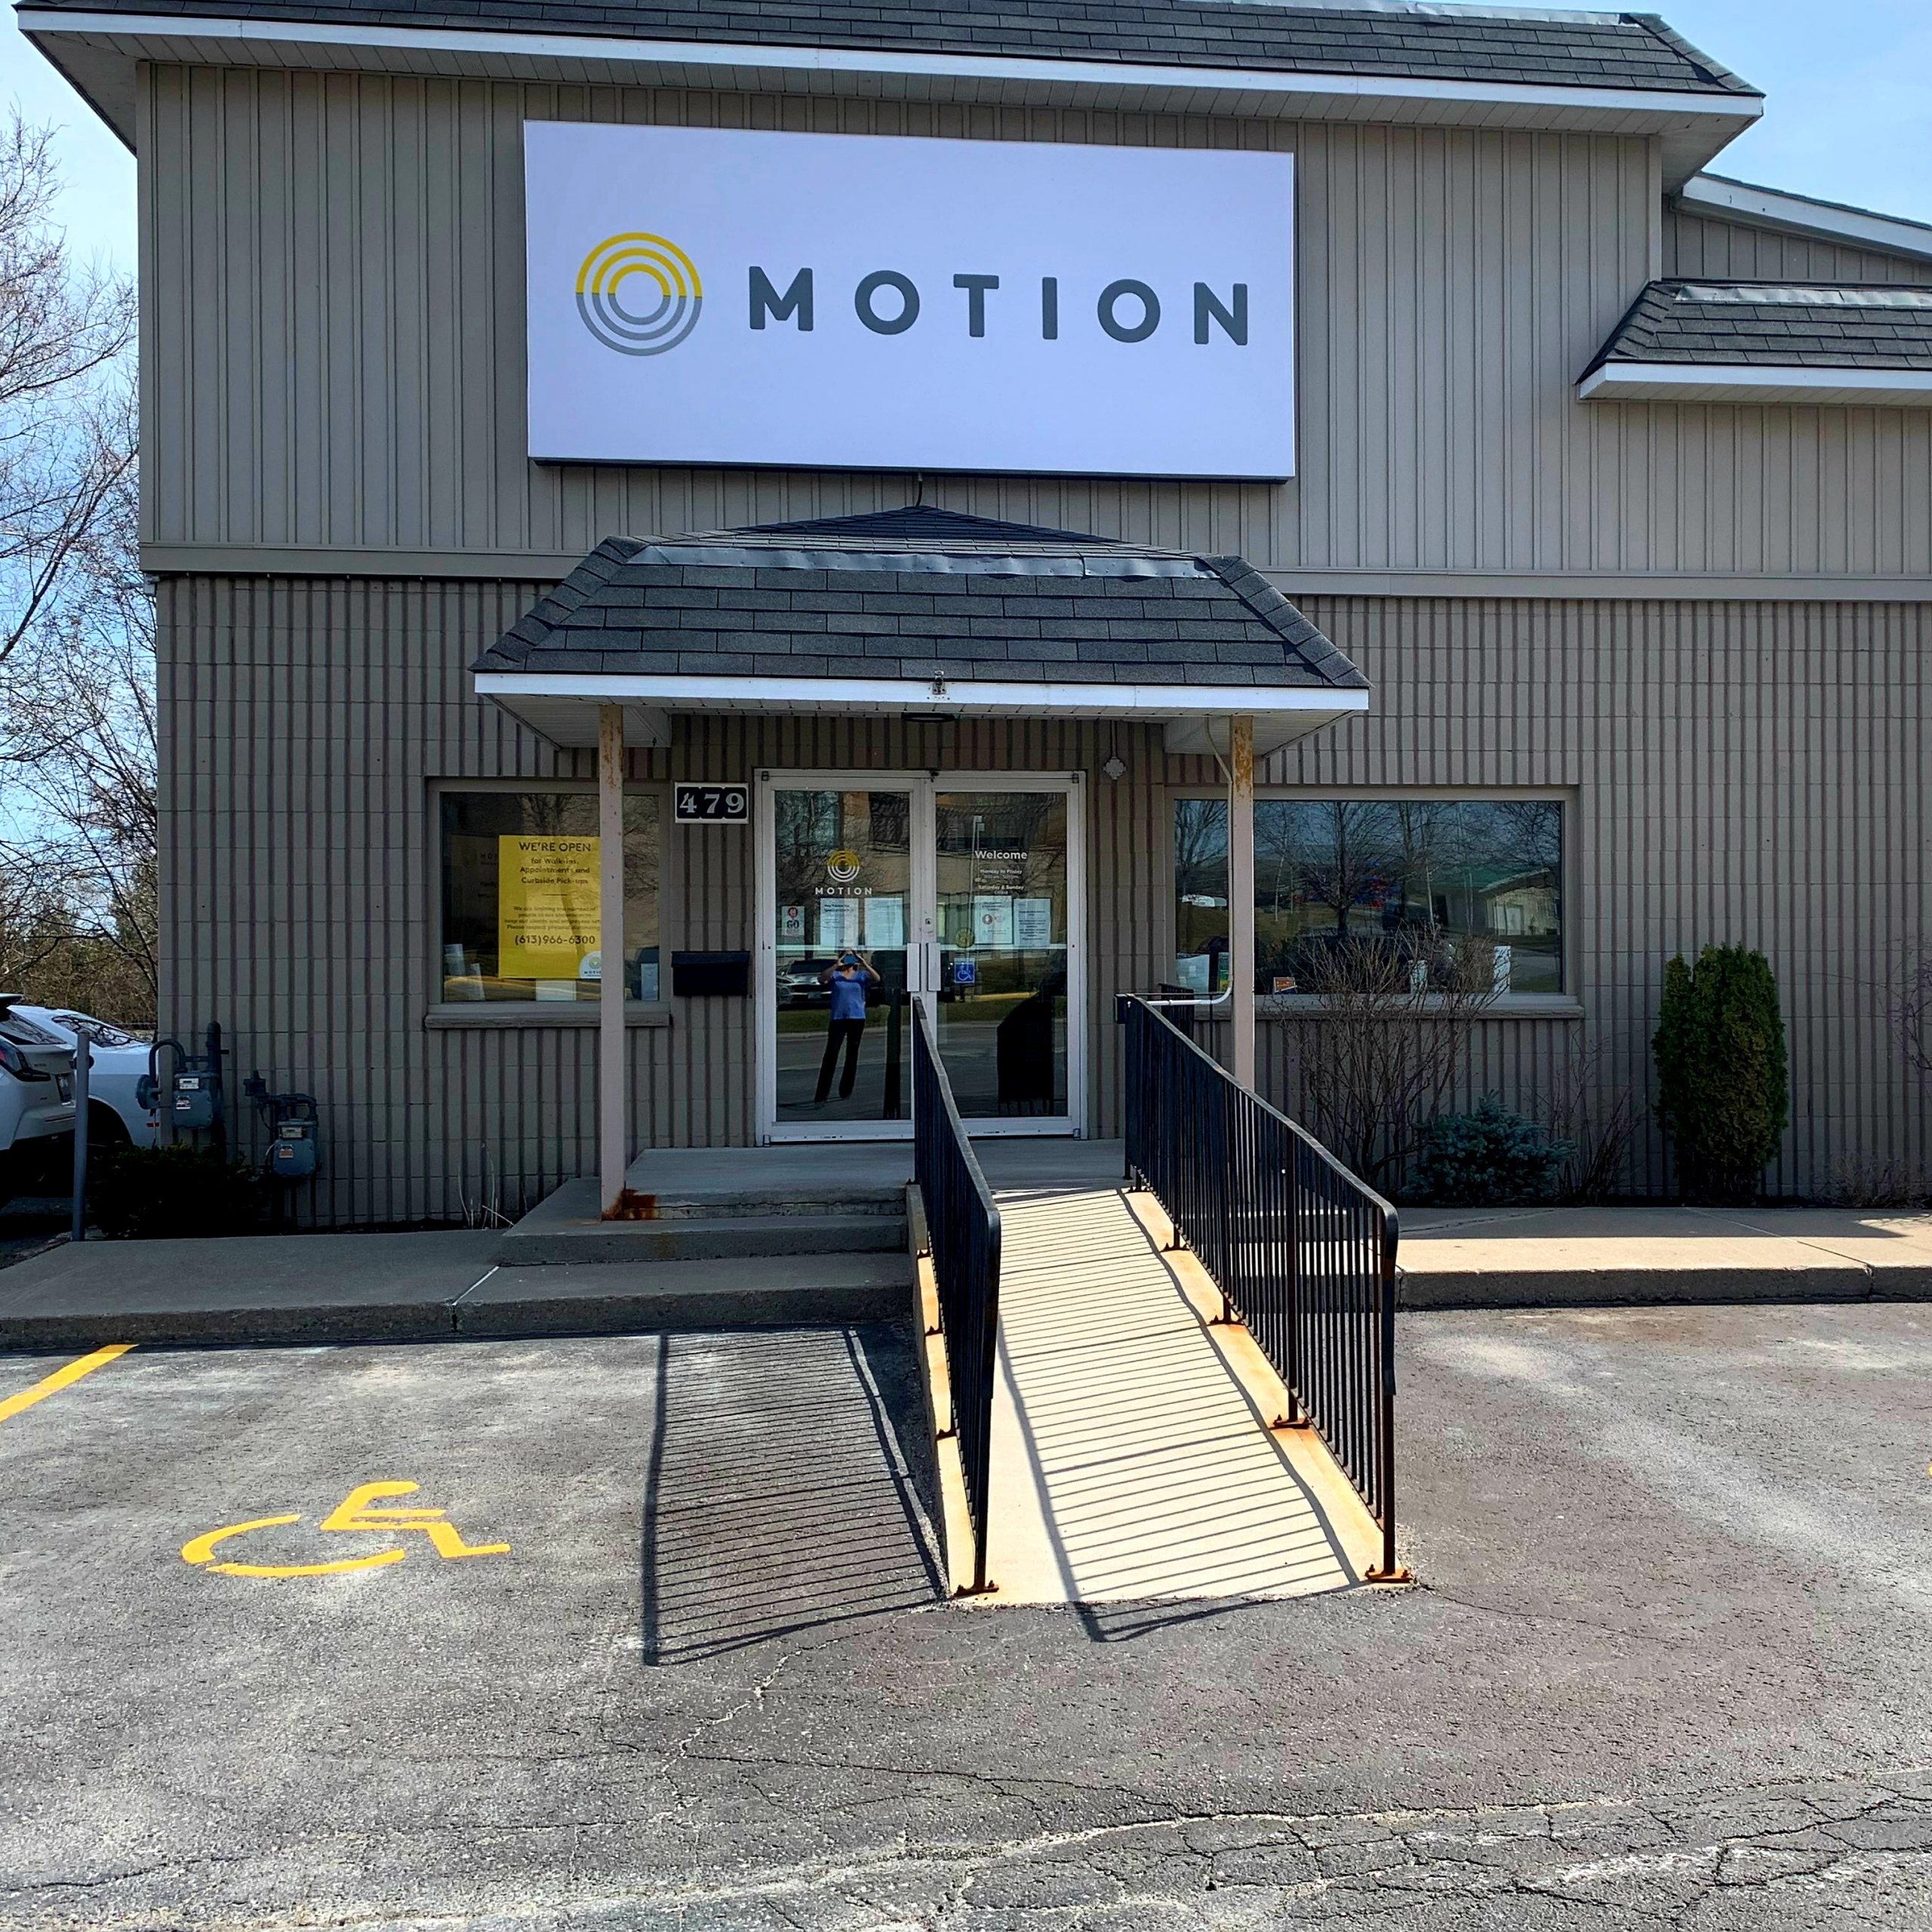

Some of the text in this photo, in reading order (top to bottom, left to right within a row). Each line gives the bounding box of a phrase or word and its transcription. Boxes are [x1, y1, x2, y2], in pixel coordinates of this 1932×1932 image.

[749, 266, 1248, 346] MOTION
[679, 792, 745, 814] 479
[518, 841, 591, 852] WE'RE OPEN
[974, 850, 1028, 860] Welcome
[519, 866, 574, 874] Appointments
[556, 877, 589, 885] Pick-ups
[815, 887, 872, 896] MOTION
[515, 935, 595, 946] (613)966-6300
